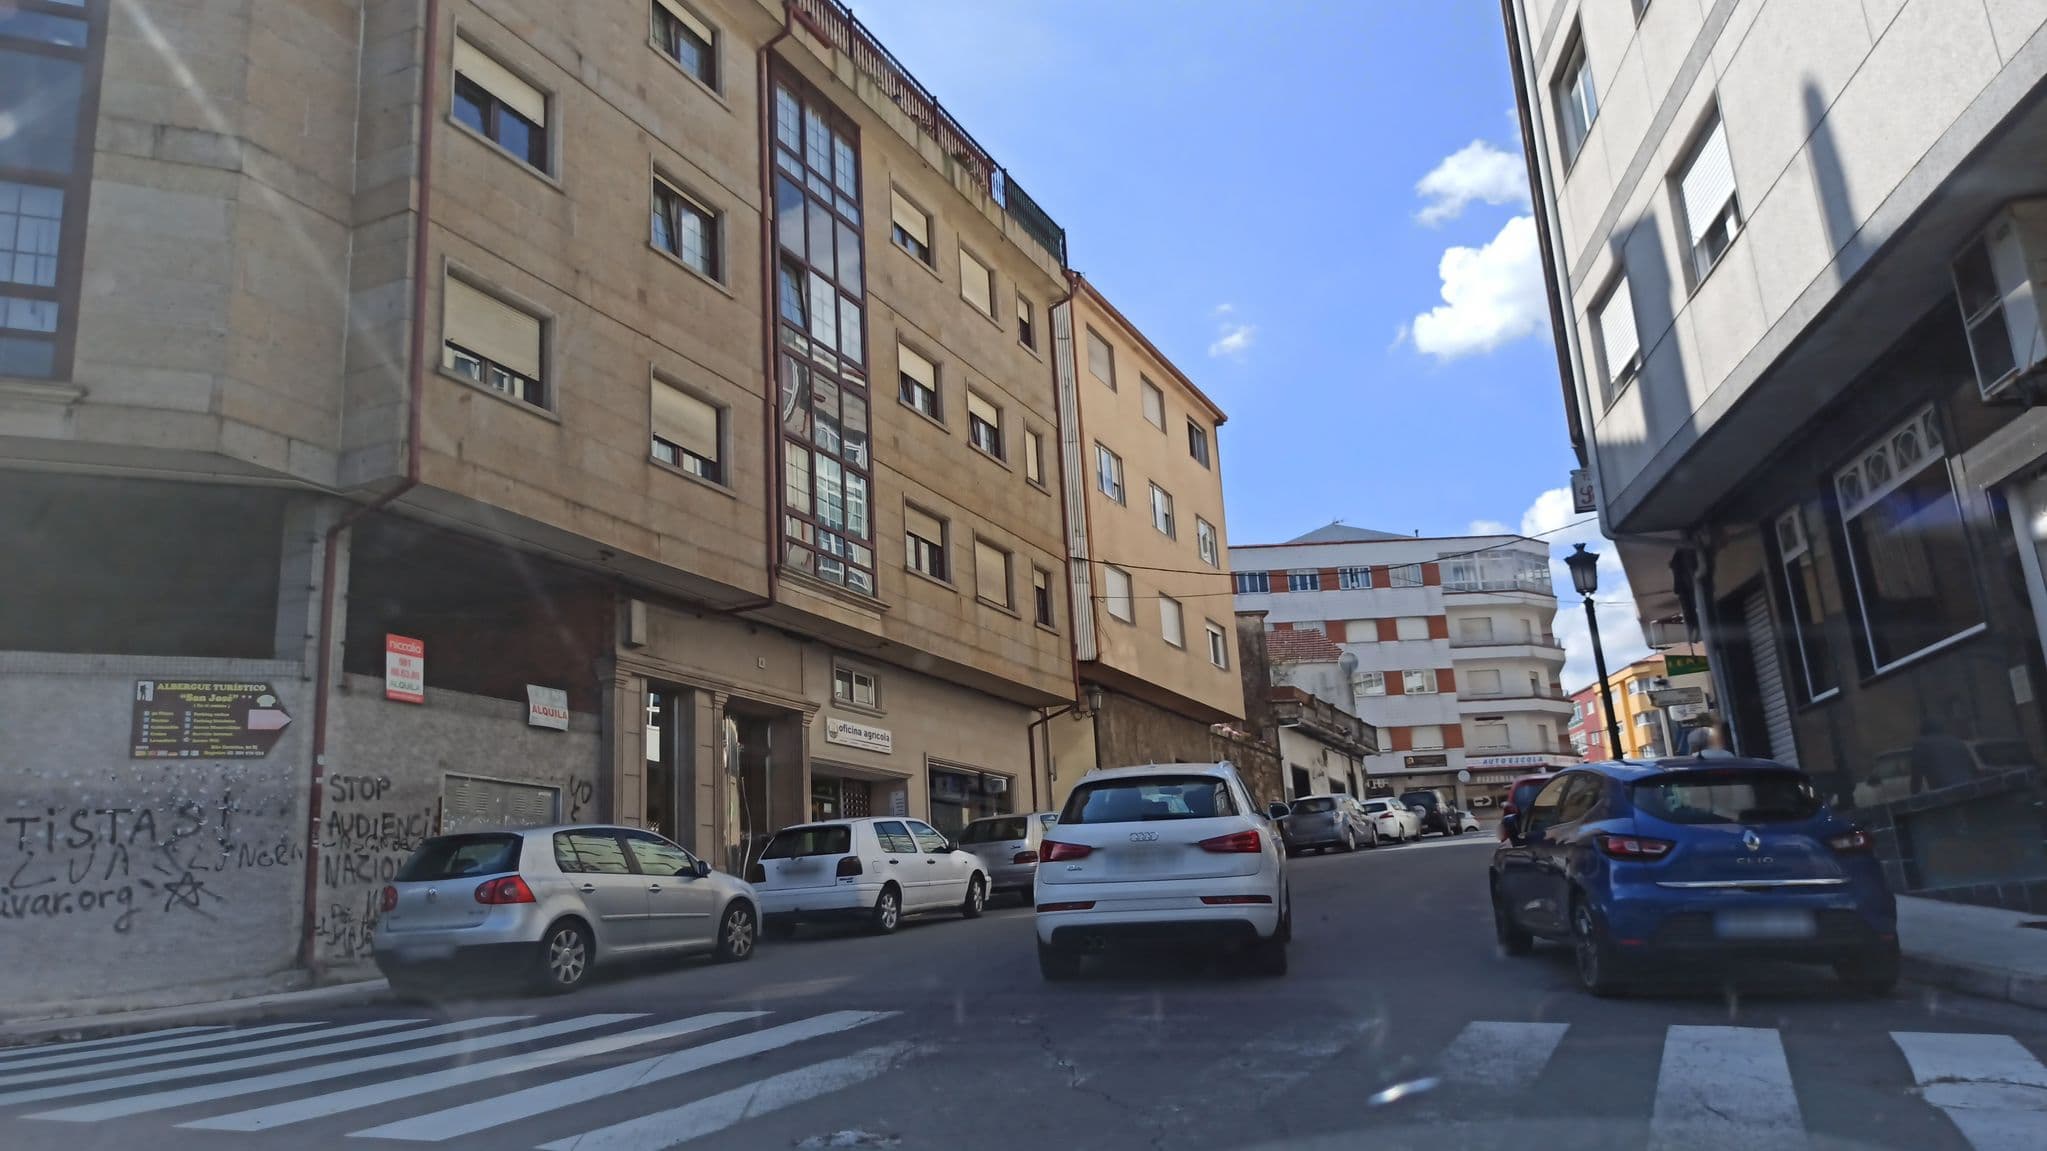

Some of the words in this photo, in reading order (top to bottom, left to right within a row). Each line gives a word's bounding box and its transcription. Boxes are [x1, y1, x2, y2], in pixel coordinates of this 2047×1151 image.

[157, 683, 211, 691] ALBERGUE
[532, 704, 568, 720] ALQUILA
[838, 724, 862, 737] oficina
[329, 773, 391, 803] STOP
